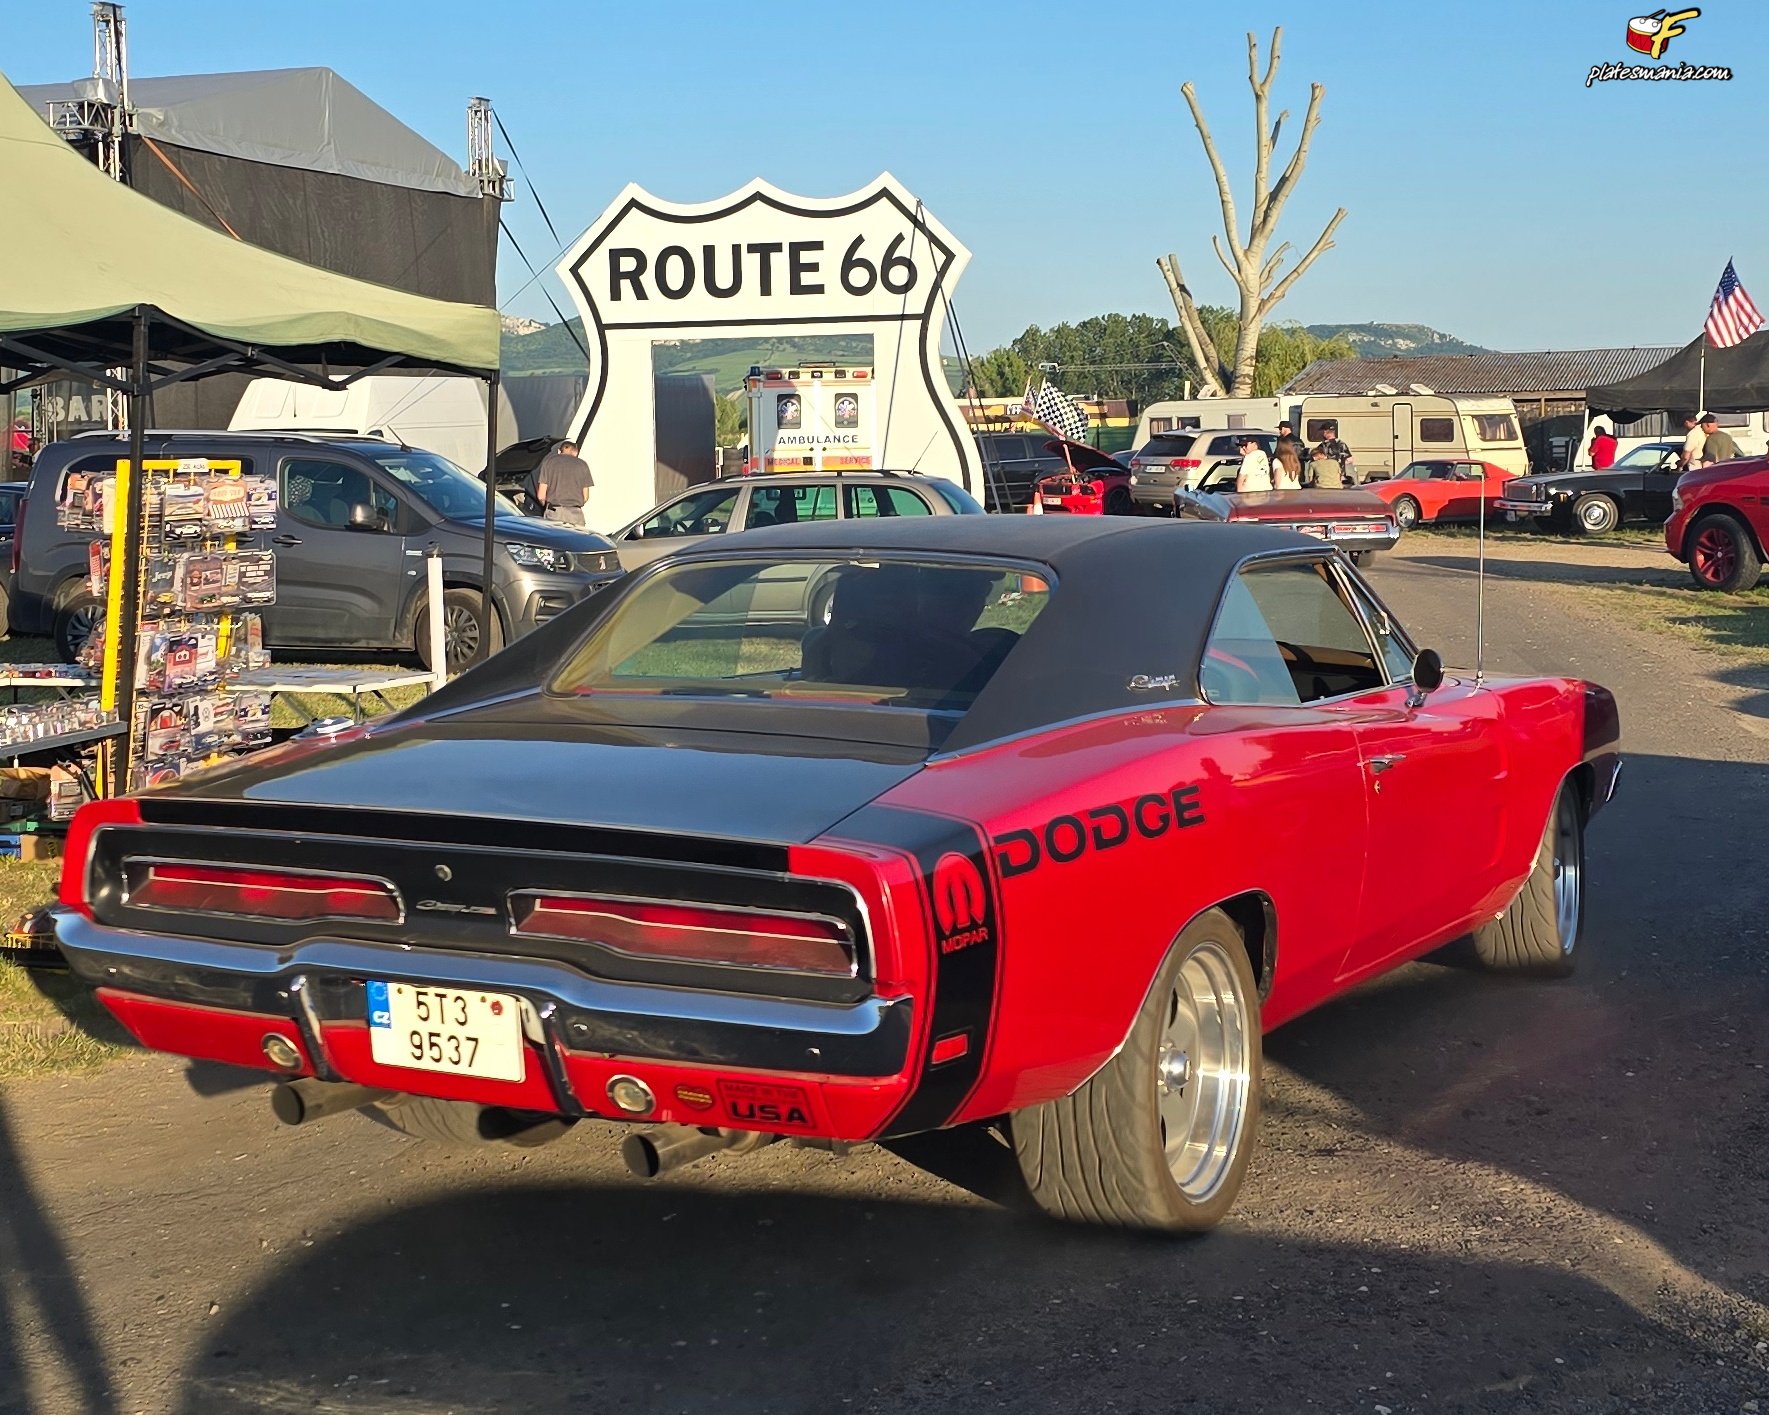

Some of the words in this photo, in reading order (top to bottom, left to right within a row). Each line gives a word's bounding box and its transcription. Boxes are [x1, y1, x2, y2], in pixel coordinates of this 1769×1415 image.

[608, 240, 826, 302] ROUTE
[840, 232, 918, 297] 66
[778, 434, 859, 445] AMBULANCE
[767, 457, 800, 466] MEDICAL
[840, 456, 871, 465] SERVICE
[993, 784, 1206, 880] DODGE
[941, 926, 990, 955] MOPAR
[373, 1010, 391, 1024] CZ
[415, 990, 469, 1027] 5T3
[409, 1029, 480, 1068] 9537
[730, 1101, 809, 1124] USA
